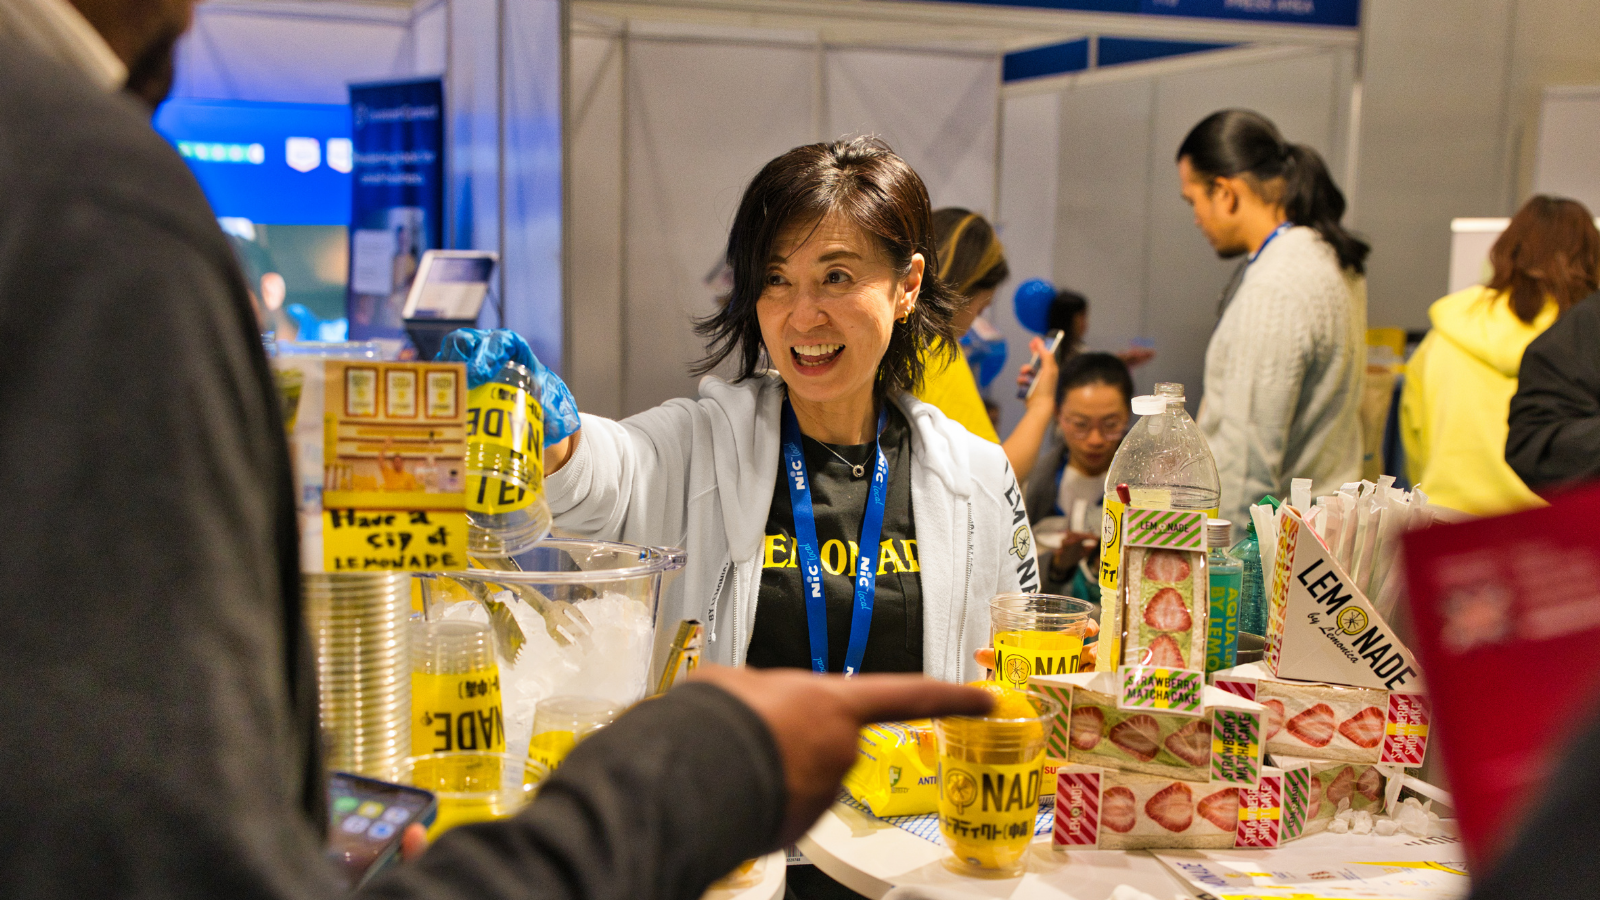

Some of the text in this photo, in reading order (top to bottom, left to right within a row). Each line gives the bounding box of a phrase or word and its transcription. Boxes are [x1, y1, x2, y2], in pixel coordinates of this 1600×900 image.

[1211, 587, 1225, 611] BY
[1224, 587, 1239, 646] AQUA
[1297, 558, 1418, 691] LEMONADE
[1319, 626, 1359, 664] Lemonica
[1128, 675, 1197, 691] SRAWBERRY
[1221, 713, 1236, 779] STRAWBERRY
[1391, 698, 1409, 758] STRAWBERRY
[1405, 728, 1419, 756] SHORT
[1258, 785, 1272, 840] SHORT CAKE
